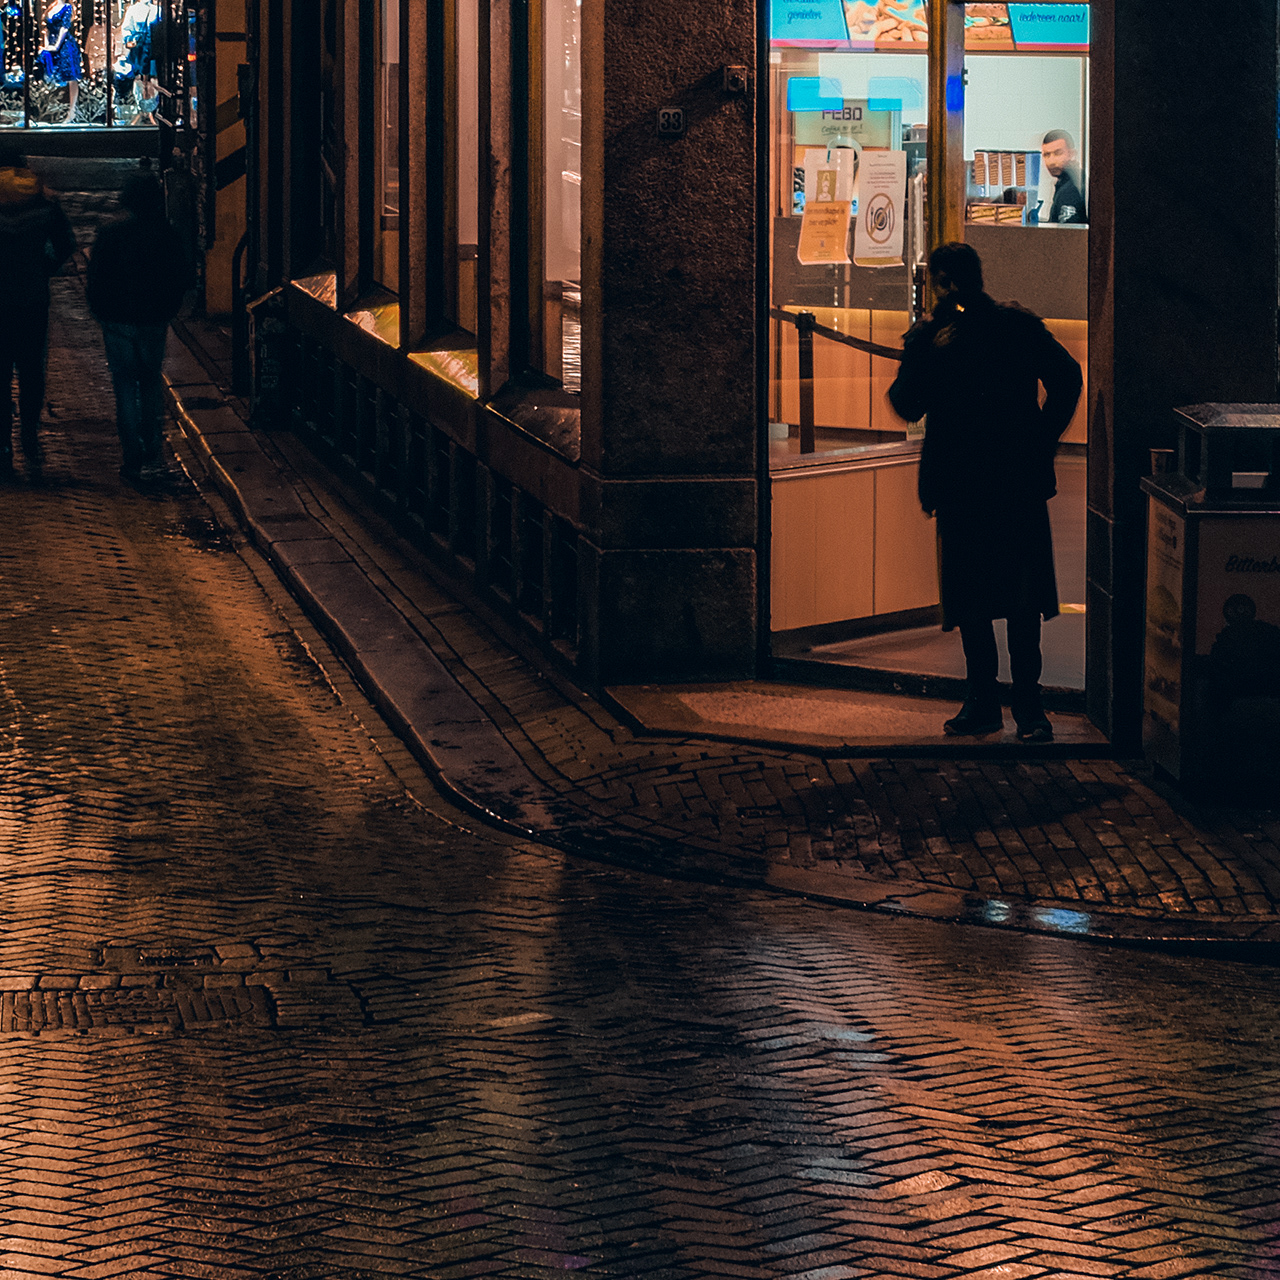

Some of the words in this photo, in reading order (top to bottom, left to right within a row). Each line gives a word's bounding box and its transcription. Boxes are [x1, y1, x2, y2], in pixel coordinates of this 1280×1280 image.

[1020, 11, 1057, 23] iedereen
[1058, 12, 1086, 23] naar!
[661, 111, 681, 130] 33
